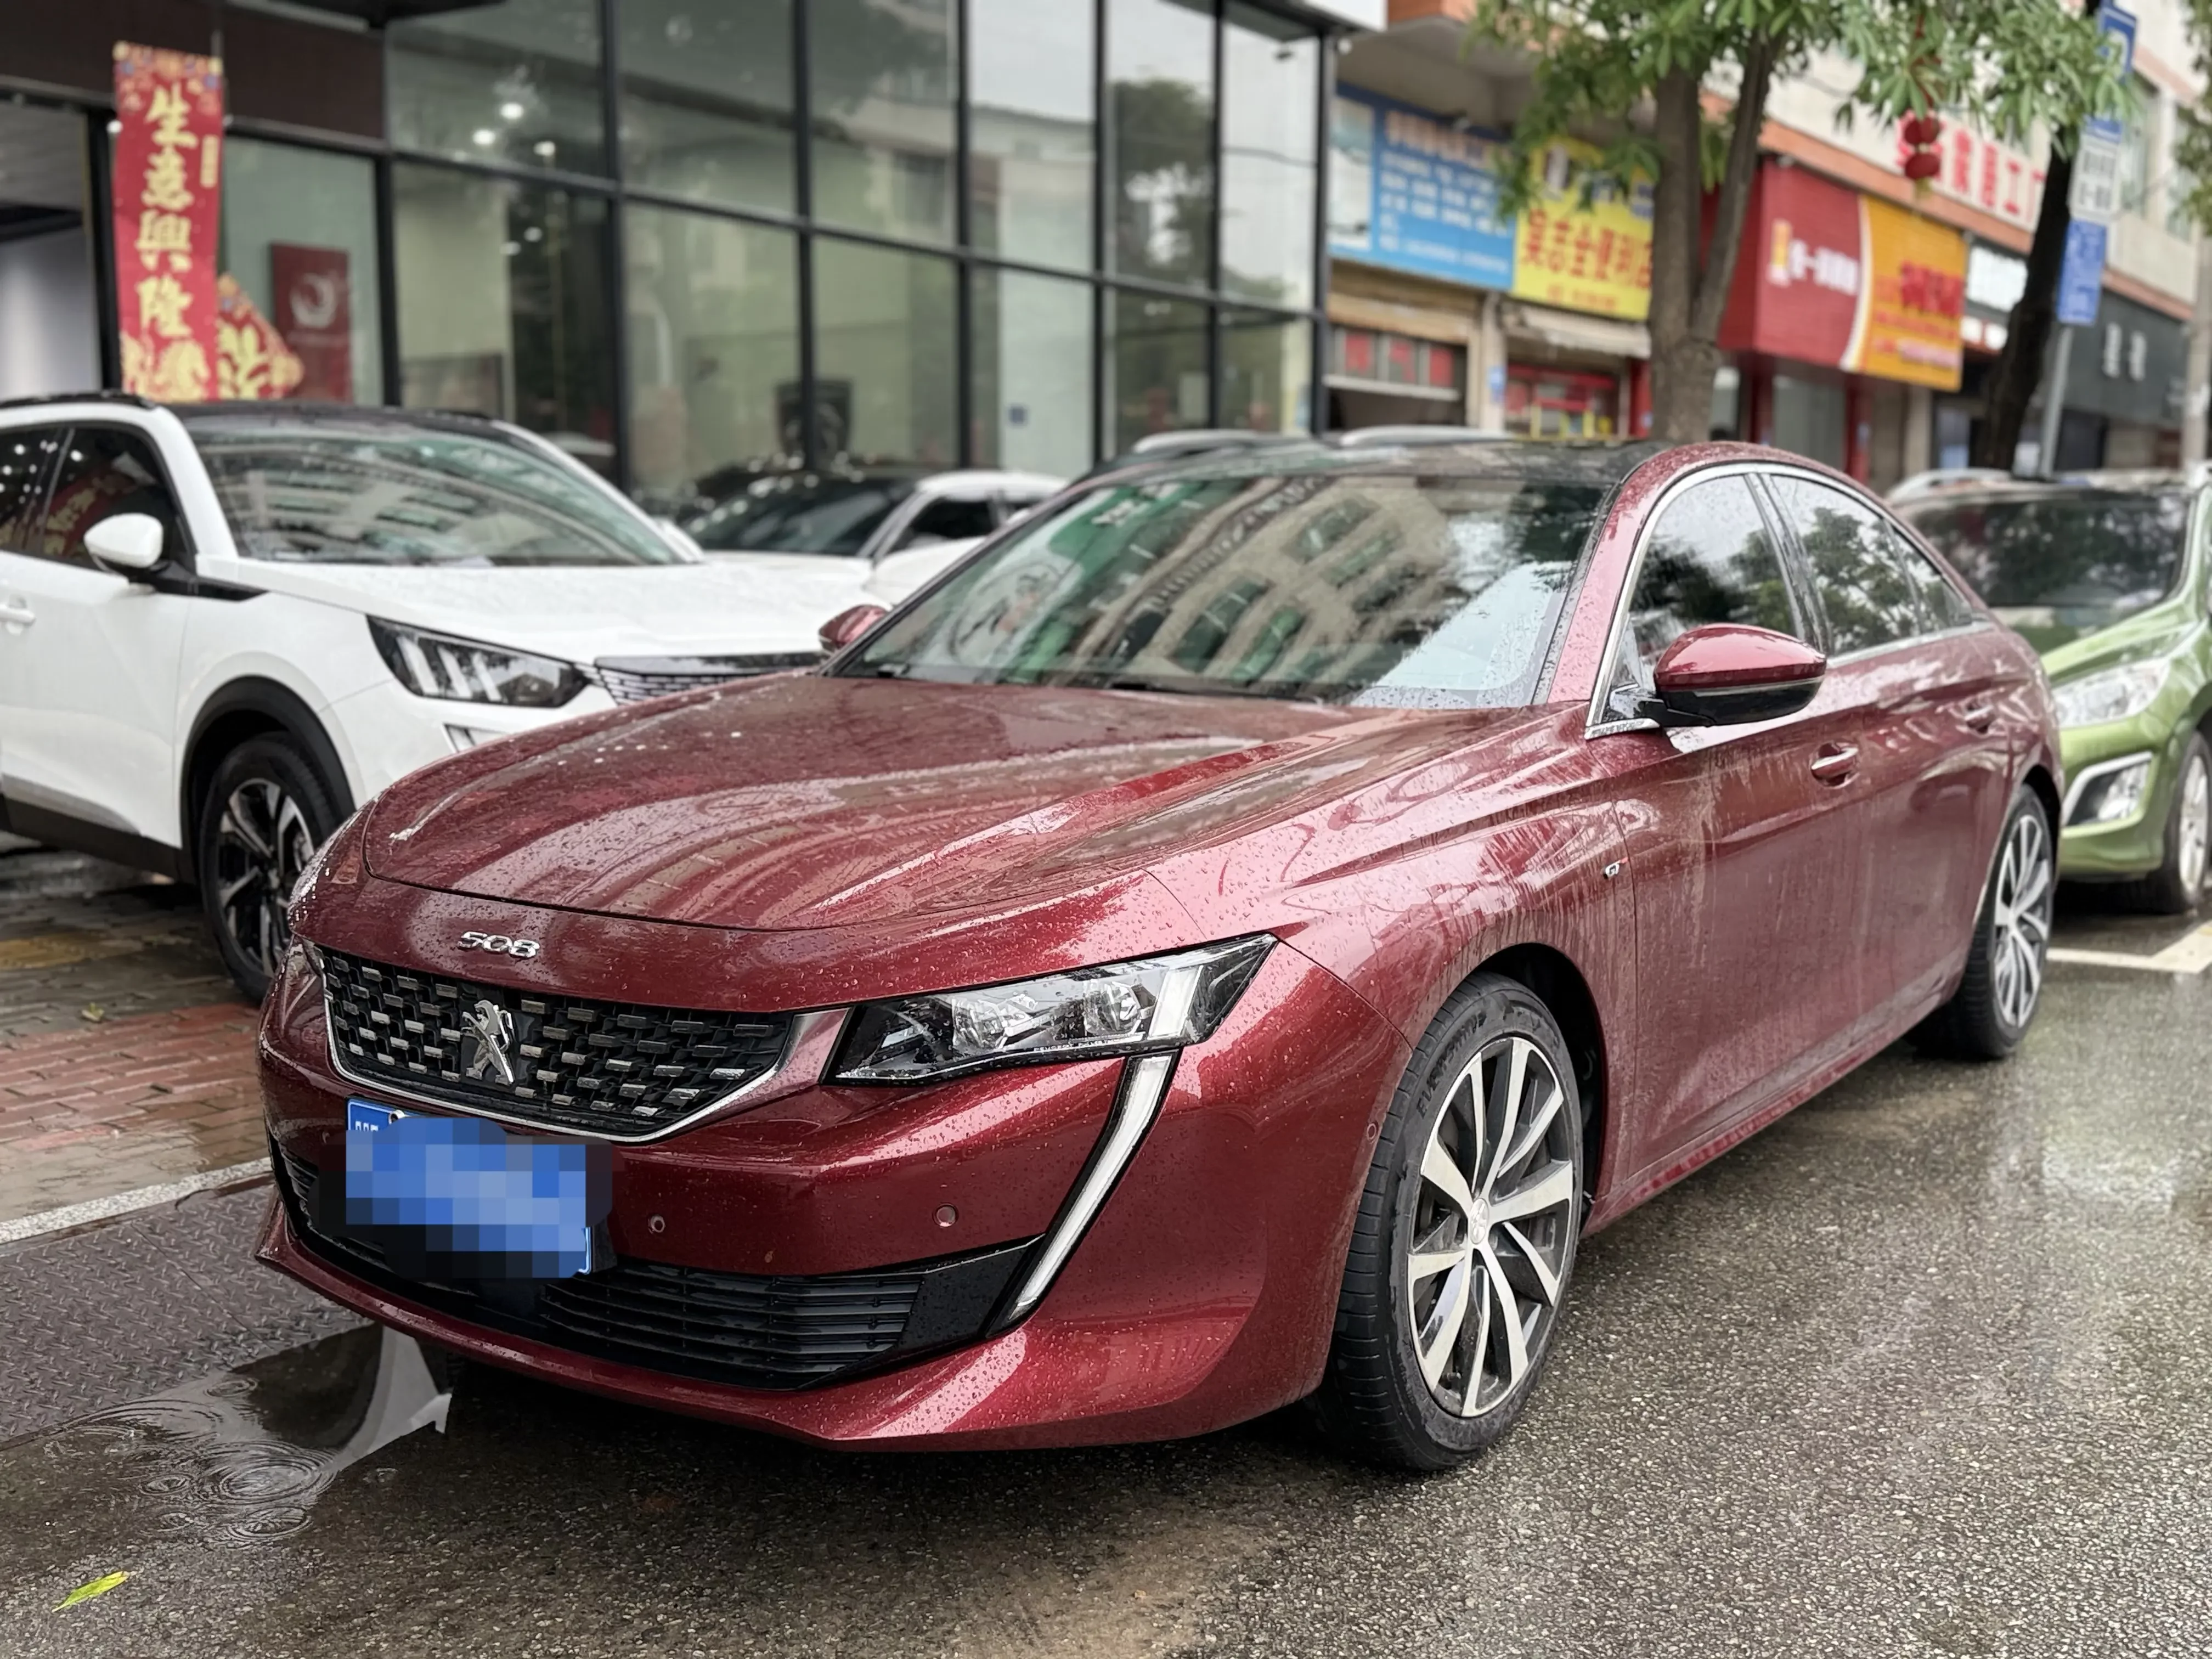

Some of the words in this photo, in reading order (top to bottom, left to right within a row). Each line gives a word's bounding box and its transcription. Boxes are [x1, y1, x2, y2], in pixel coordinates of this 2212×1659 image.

[135, 83, 199, 337] 生意興隆
[457, 931, 540, 958] 508
